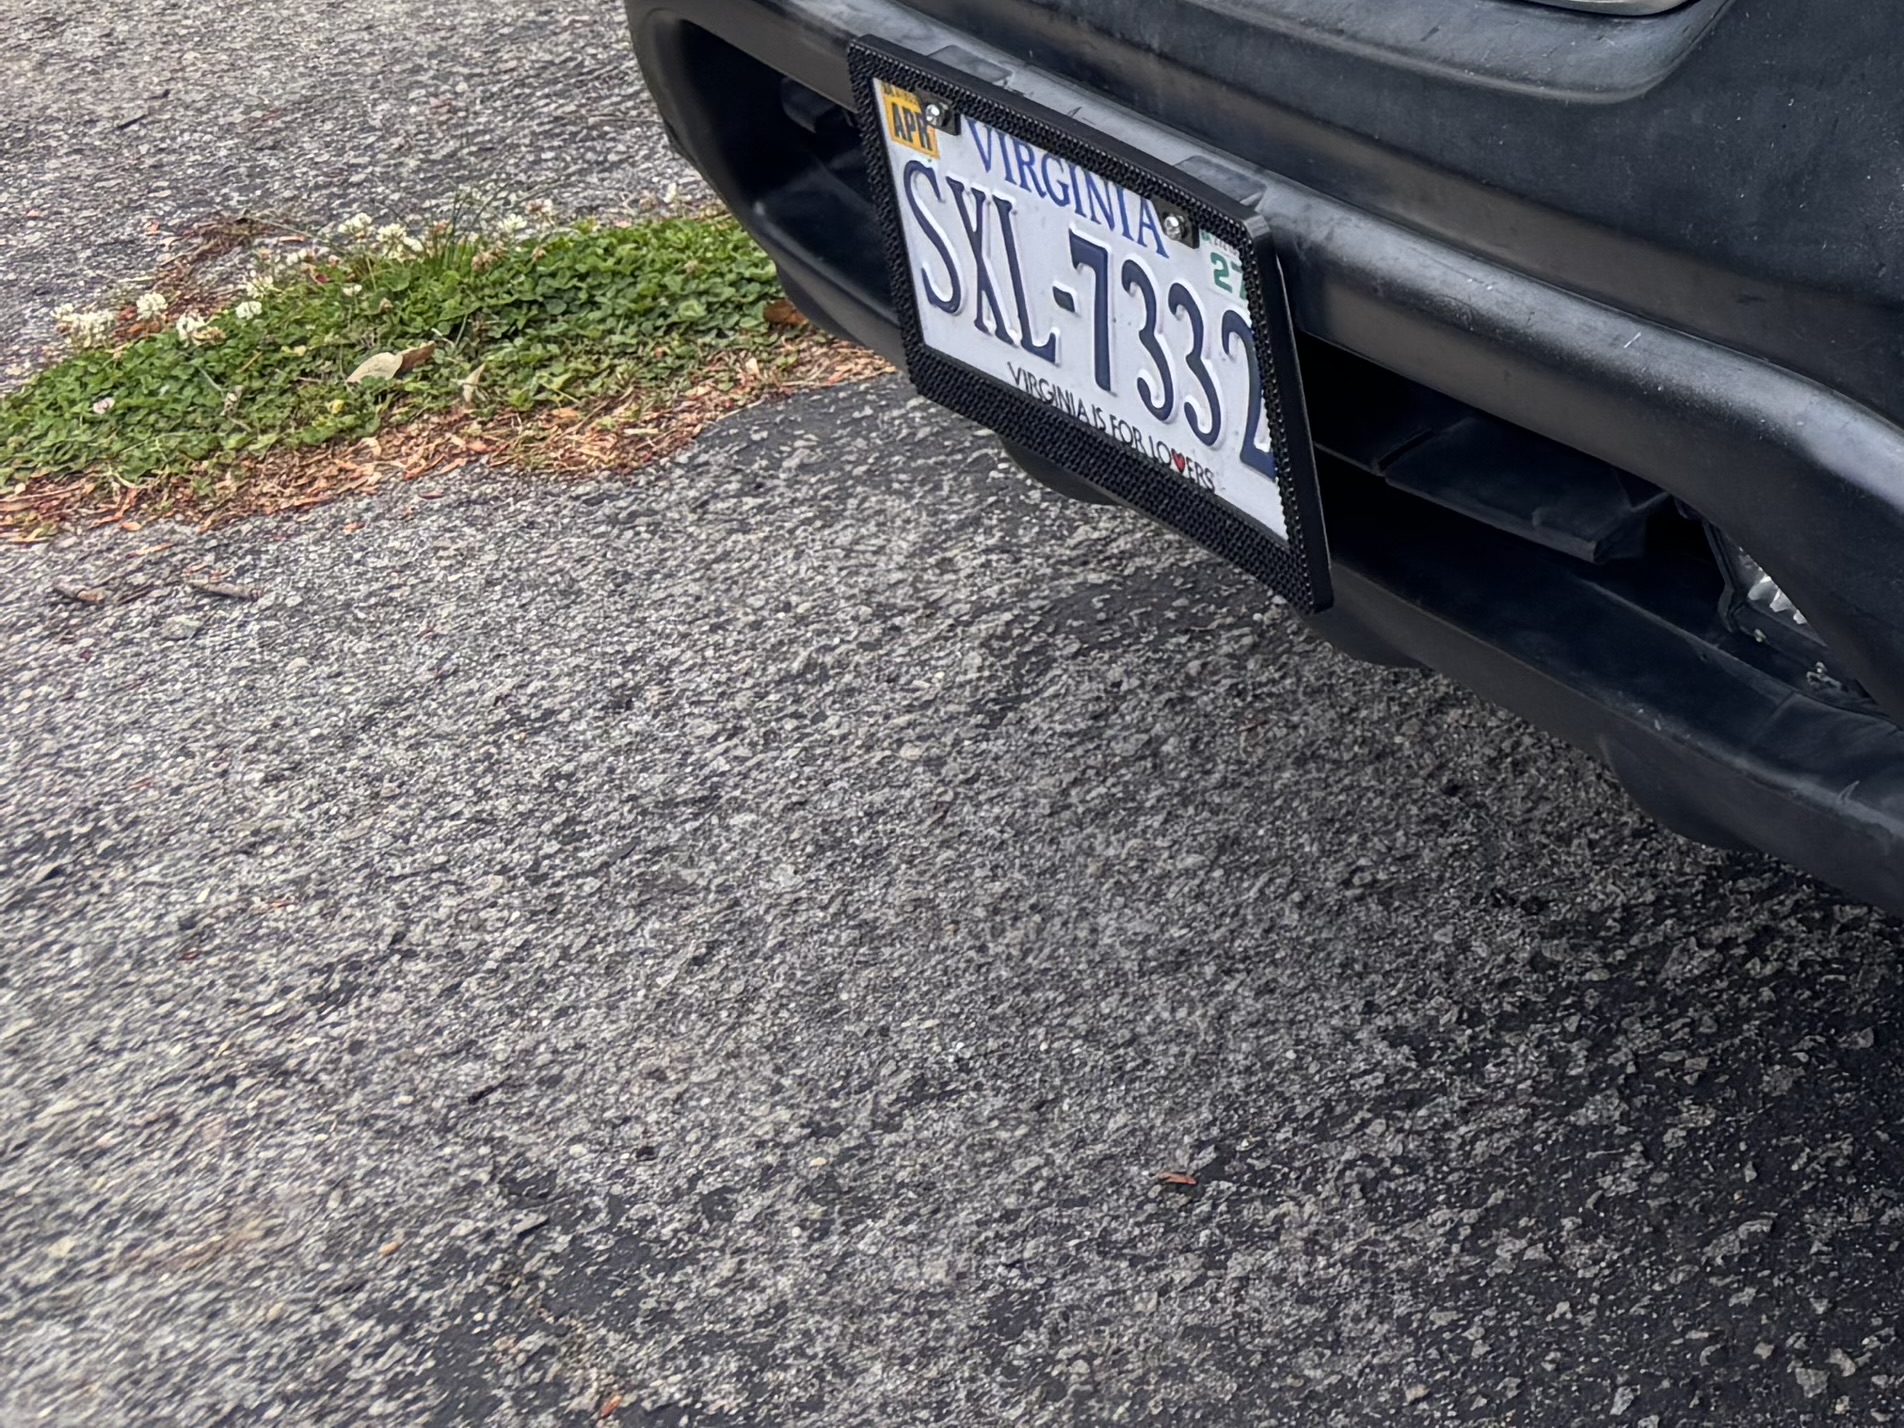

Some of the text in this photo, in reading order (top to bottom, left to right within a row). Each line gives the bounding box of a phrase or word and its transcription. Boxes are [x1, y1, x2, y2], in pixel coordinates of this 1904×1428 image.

[890, 102, 934, 152] APR
[964, 117, 1170, 260] VIRGINIA
[903, 159, 1277, 481] SXL-7332
[1006, 361, 1090, 424] VIRGINIA
[1091, 403, 1107, 432] IS
[1109, 413, 1147, 456] FOR
